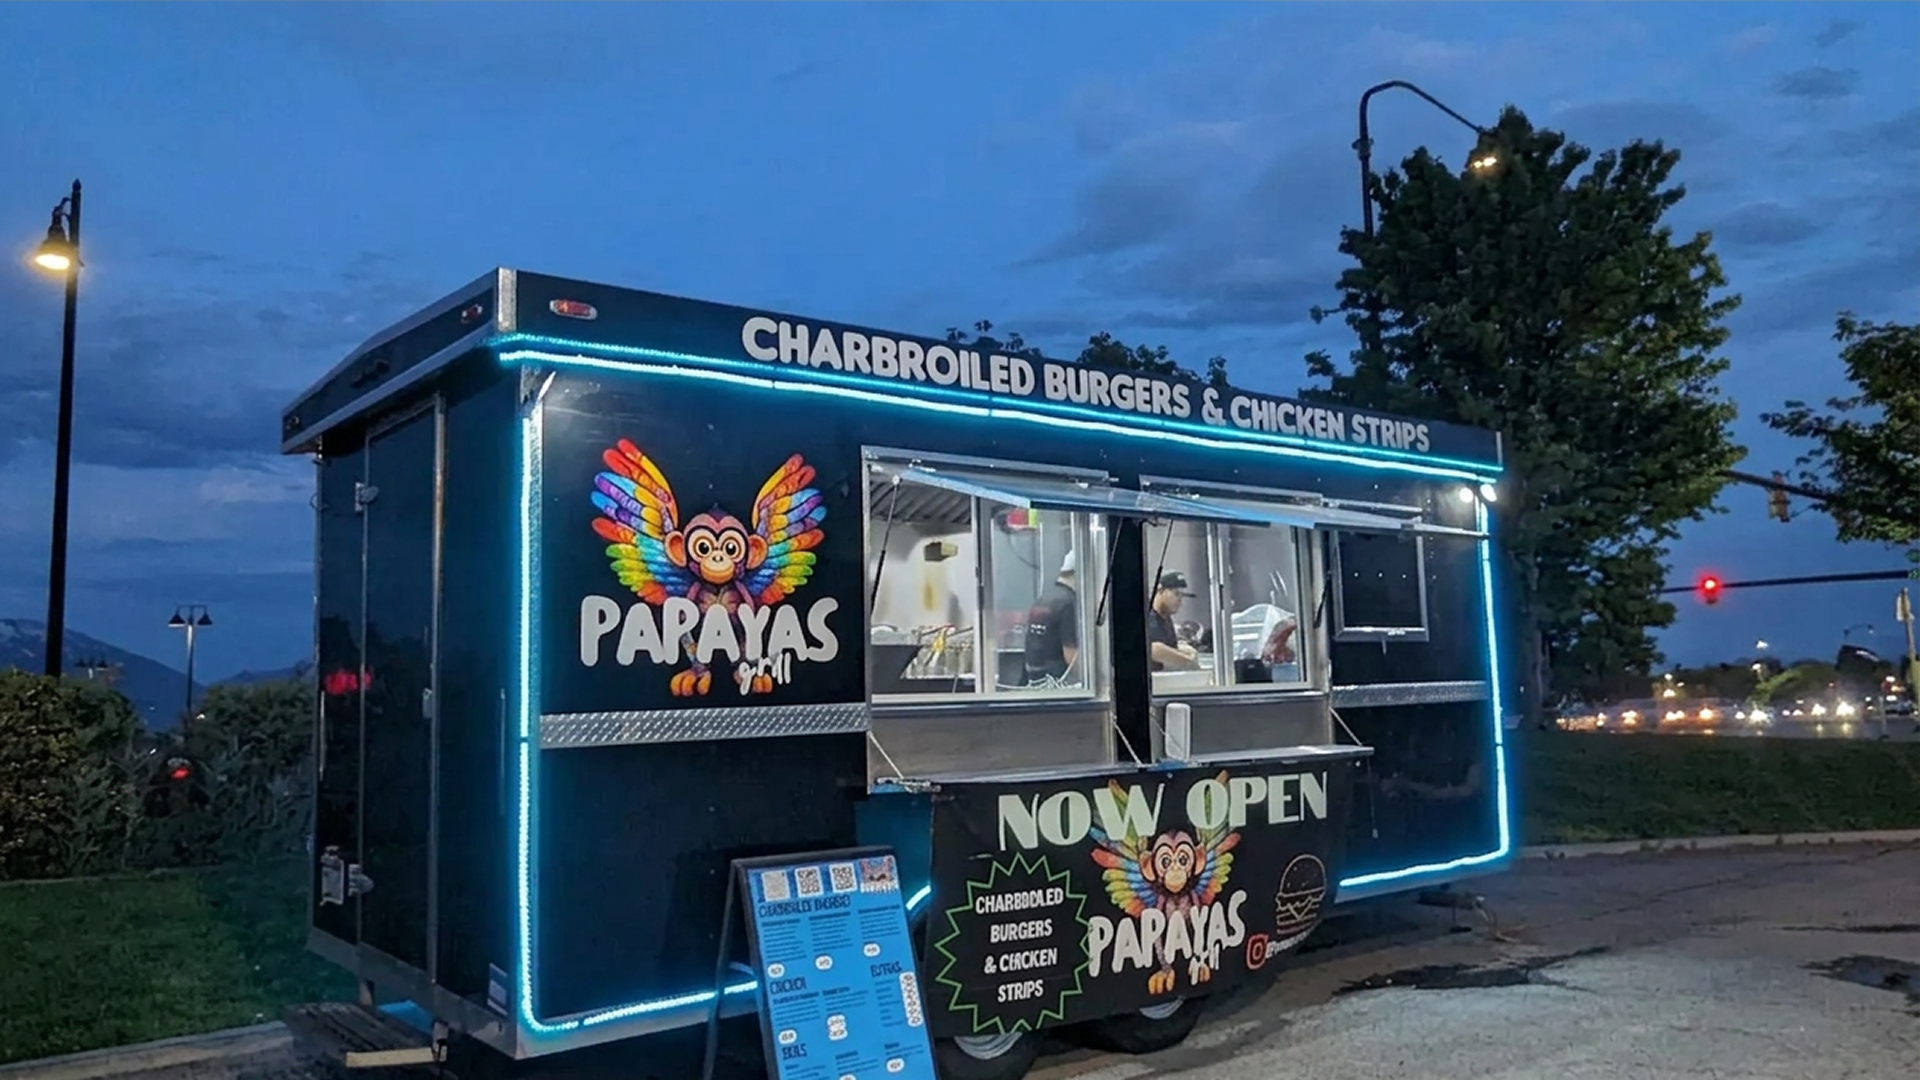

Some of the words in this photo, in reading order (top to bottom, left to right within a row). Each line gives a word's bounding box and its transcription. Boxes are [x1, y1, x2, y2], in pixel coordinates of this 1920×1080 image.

[741, 316, 1035, 396] CHARBROILED
[1044, 363, 1191, 418] BURGERS
[1201, 387, 1227, 426] &
[1230, 395, 1345, 440] CHICKEN
[1351, 413, 1430, 452] STRIPS
[580, 595, 839, 667] PAPAYAS
[998, 782, 1165, 851] NOW
[1186, 771, 1327, 829] OPEN
[984, 955, 997, 974] &
[990, 918, 1053, 943] BURGERS
[1088, 890, 1247, 977] PAPAYAS
[997, 979, 1044, 1003] STRIPS
